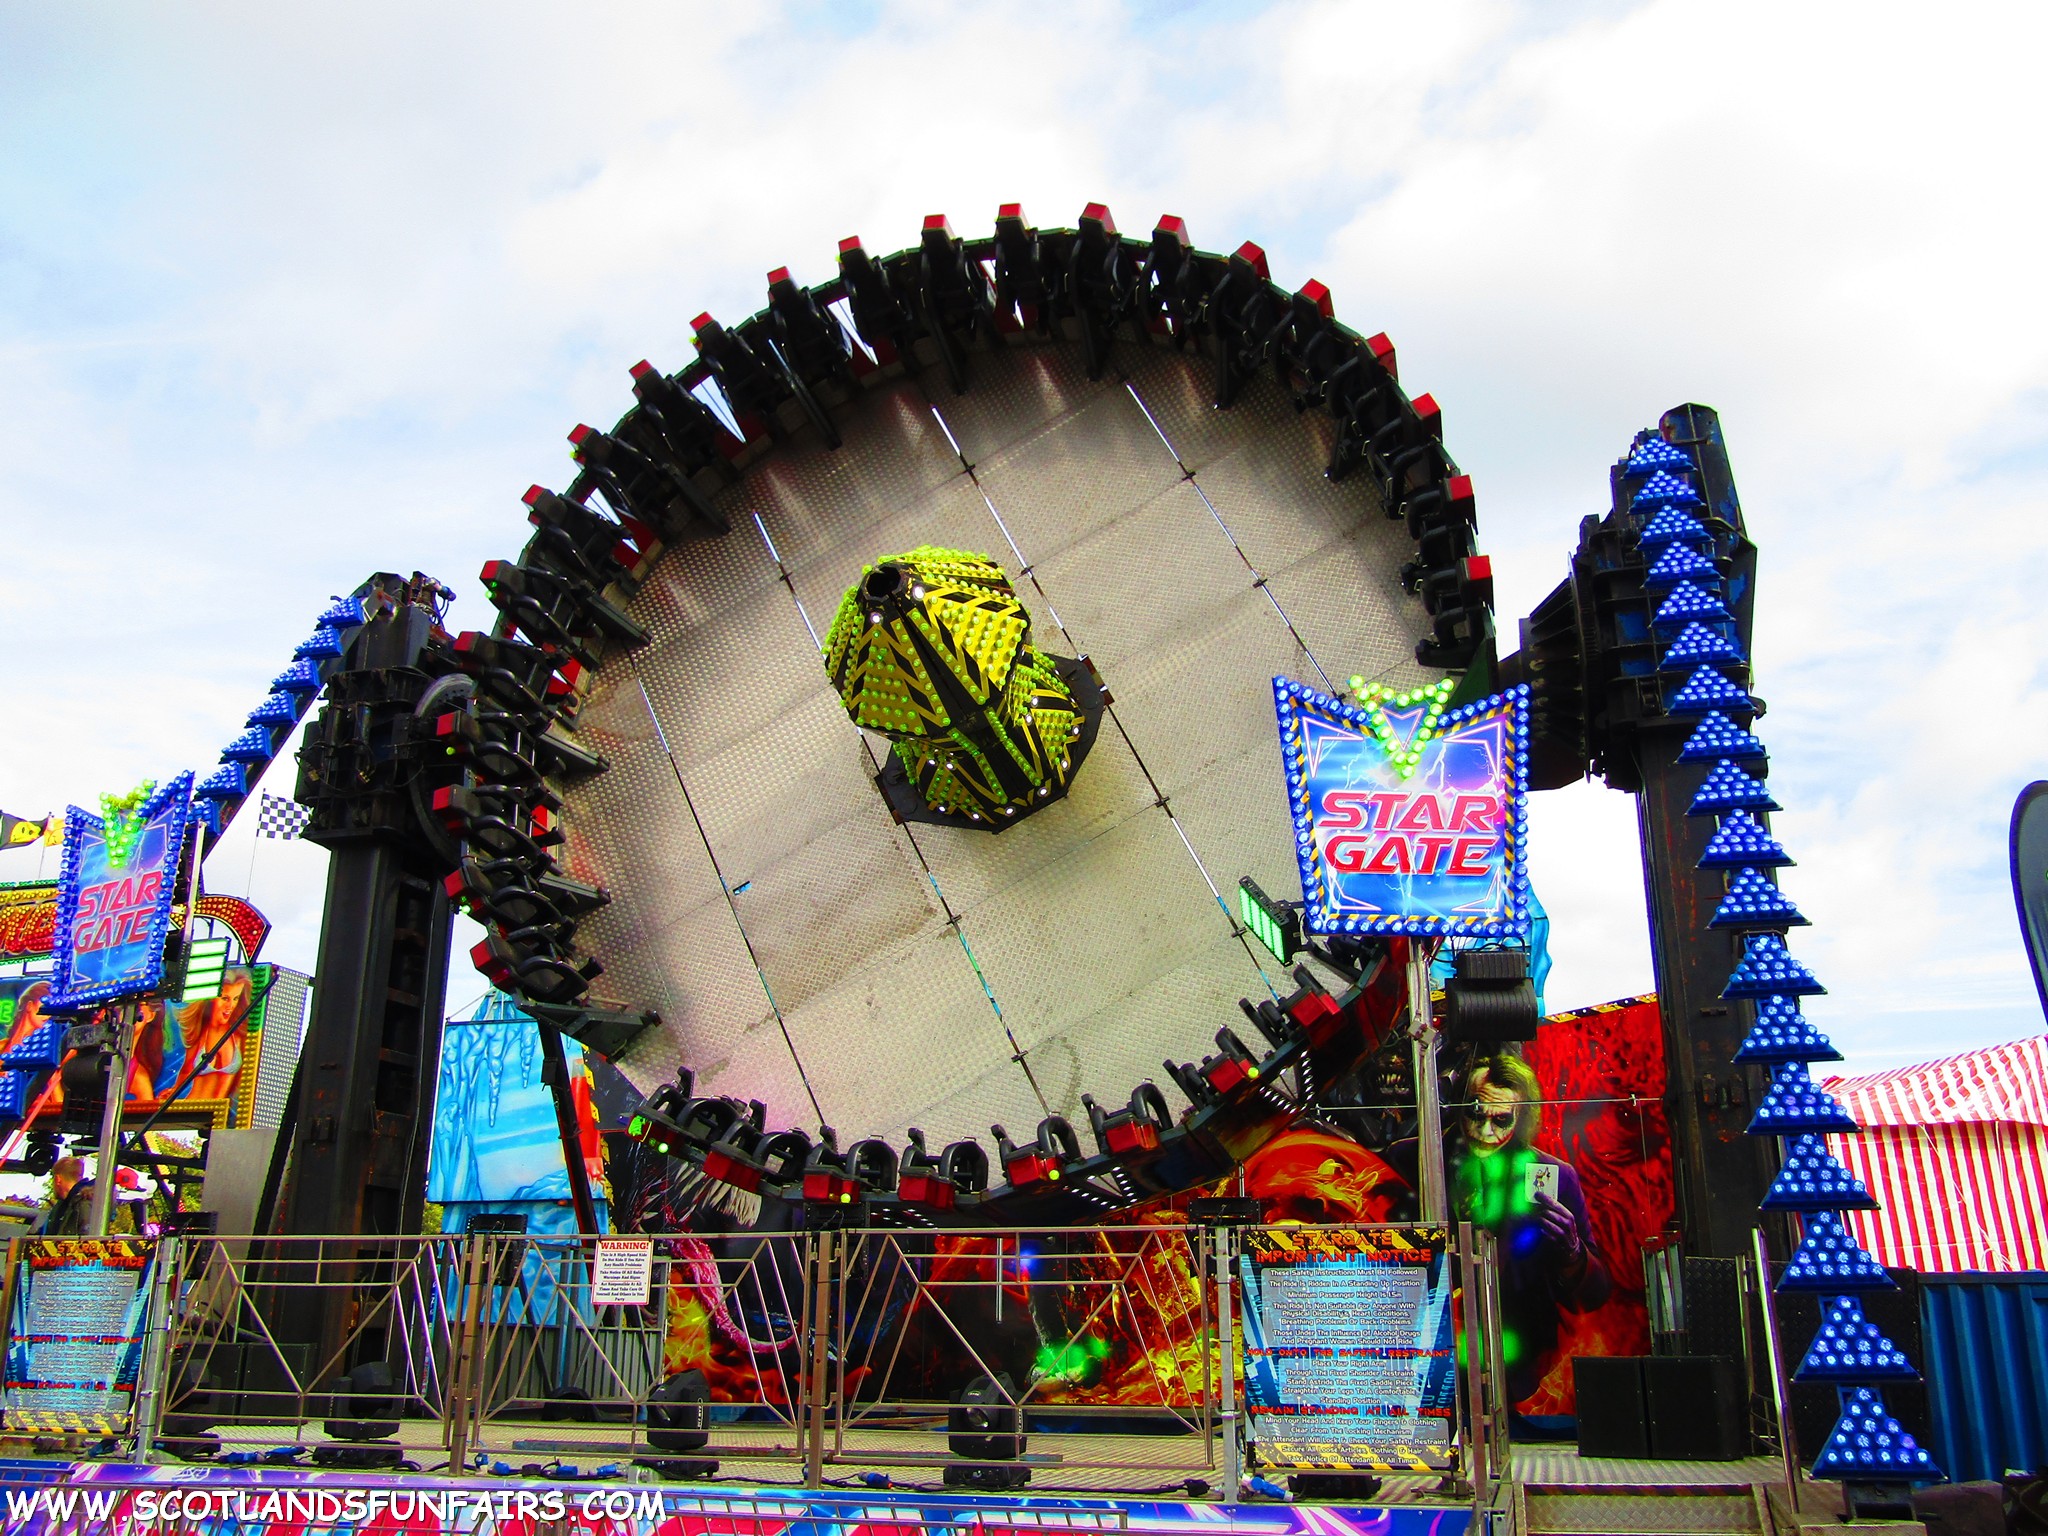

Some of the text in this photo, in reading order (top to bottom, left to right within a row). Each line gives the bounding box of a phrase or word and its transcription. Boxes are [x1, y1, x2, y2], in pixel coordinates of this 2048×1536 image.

[1318, 790, 1498, 832] STAR
[1324, 834, 1500, 876] GATE
[74, 870, 164, 919] STAR
[73, 906, 157, 955] GATE
[1292, 1233, 1393, 1246] STARGATE
[601, 1242, 649, 1250] WARNING!
[1256, 1249, 1432, 1263] IMPORTANT NOTICE
[1292, 1269, 1314, 1277] Safety
[1349, 1280, 1378, 1288] Standing
[1381, 1280, 1390, 1288] Up
[1319, 1291, 1355, 1299] Passenger
[1356, 1291, 1378, 1299] Height
[1373, 1302, 1397, 1310] Anyone
[1281, 1319, 1313, 1327] Breathing
[1400, 1330, 1421, 1338] Drugs
[1297, 1338, 1328, 1346] Pregnant
[1251, 1406, 1451, 1416] REMAIN STANDING AT ALL TIMES
